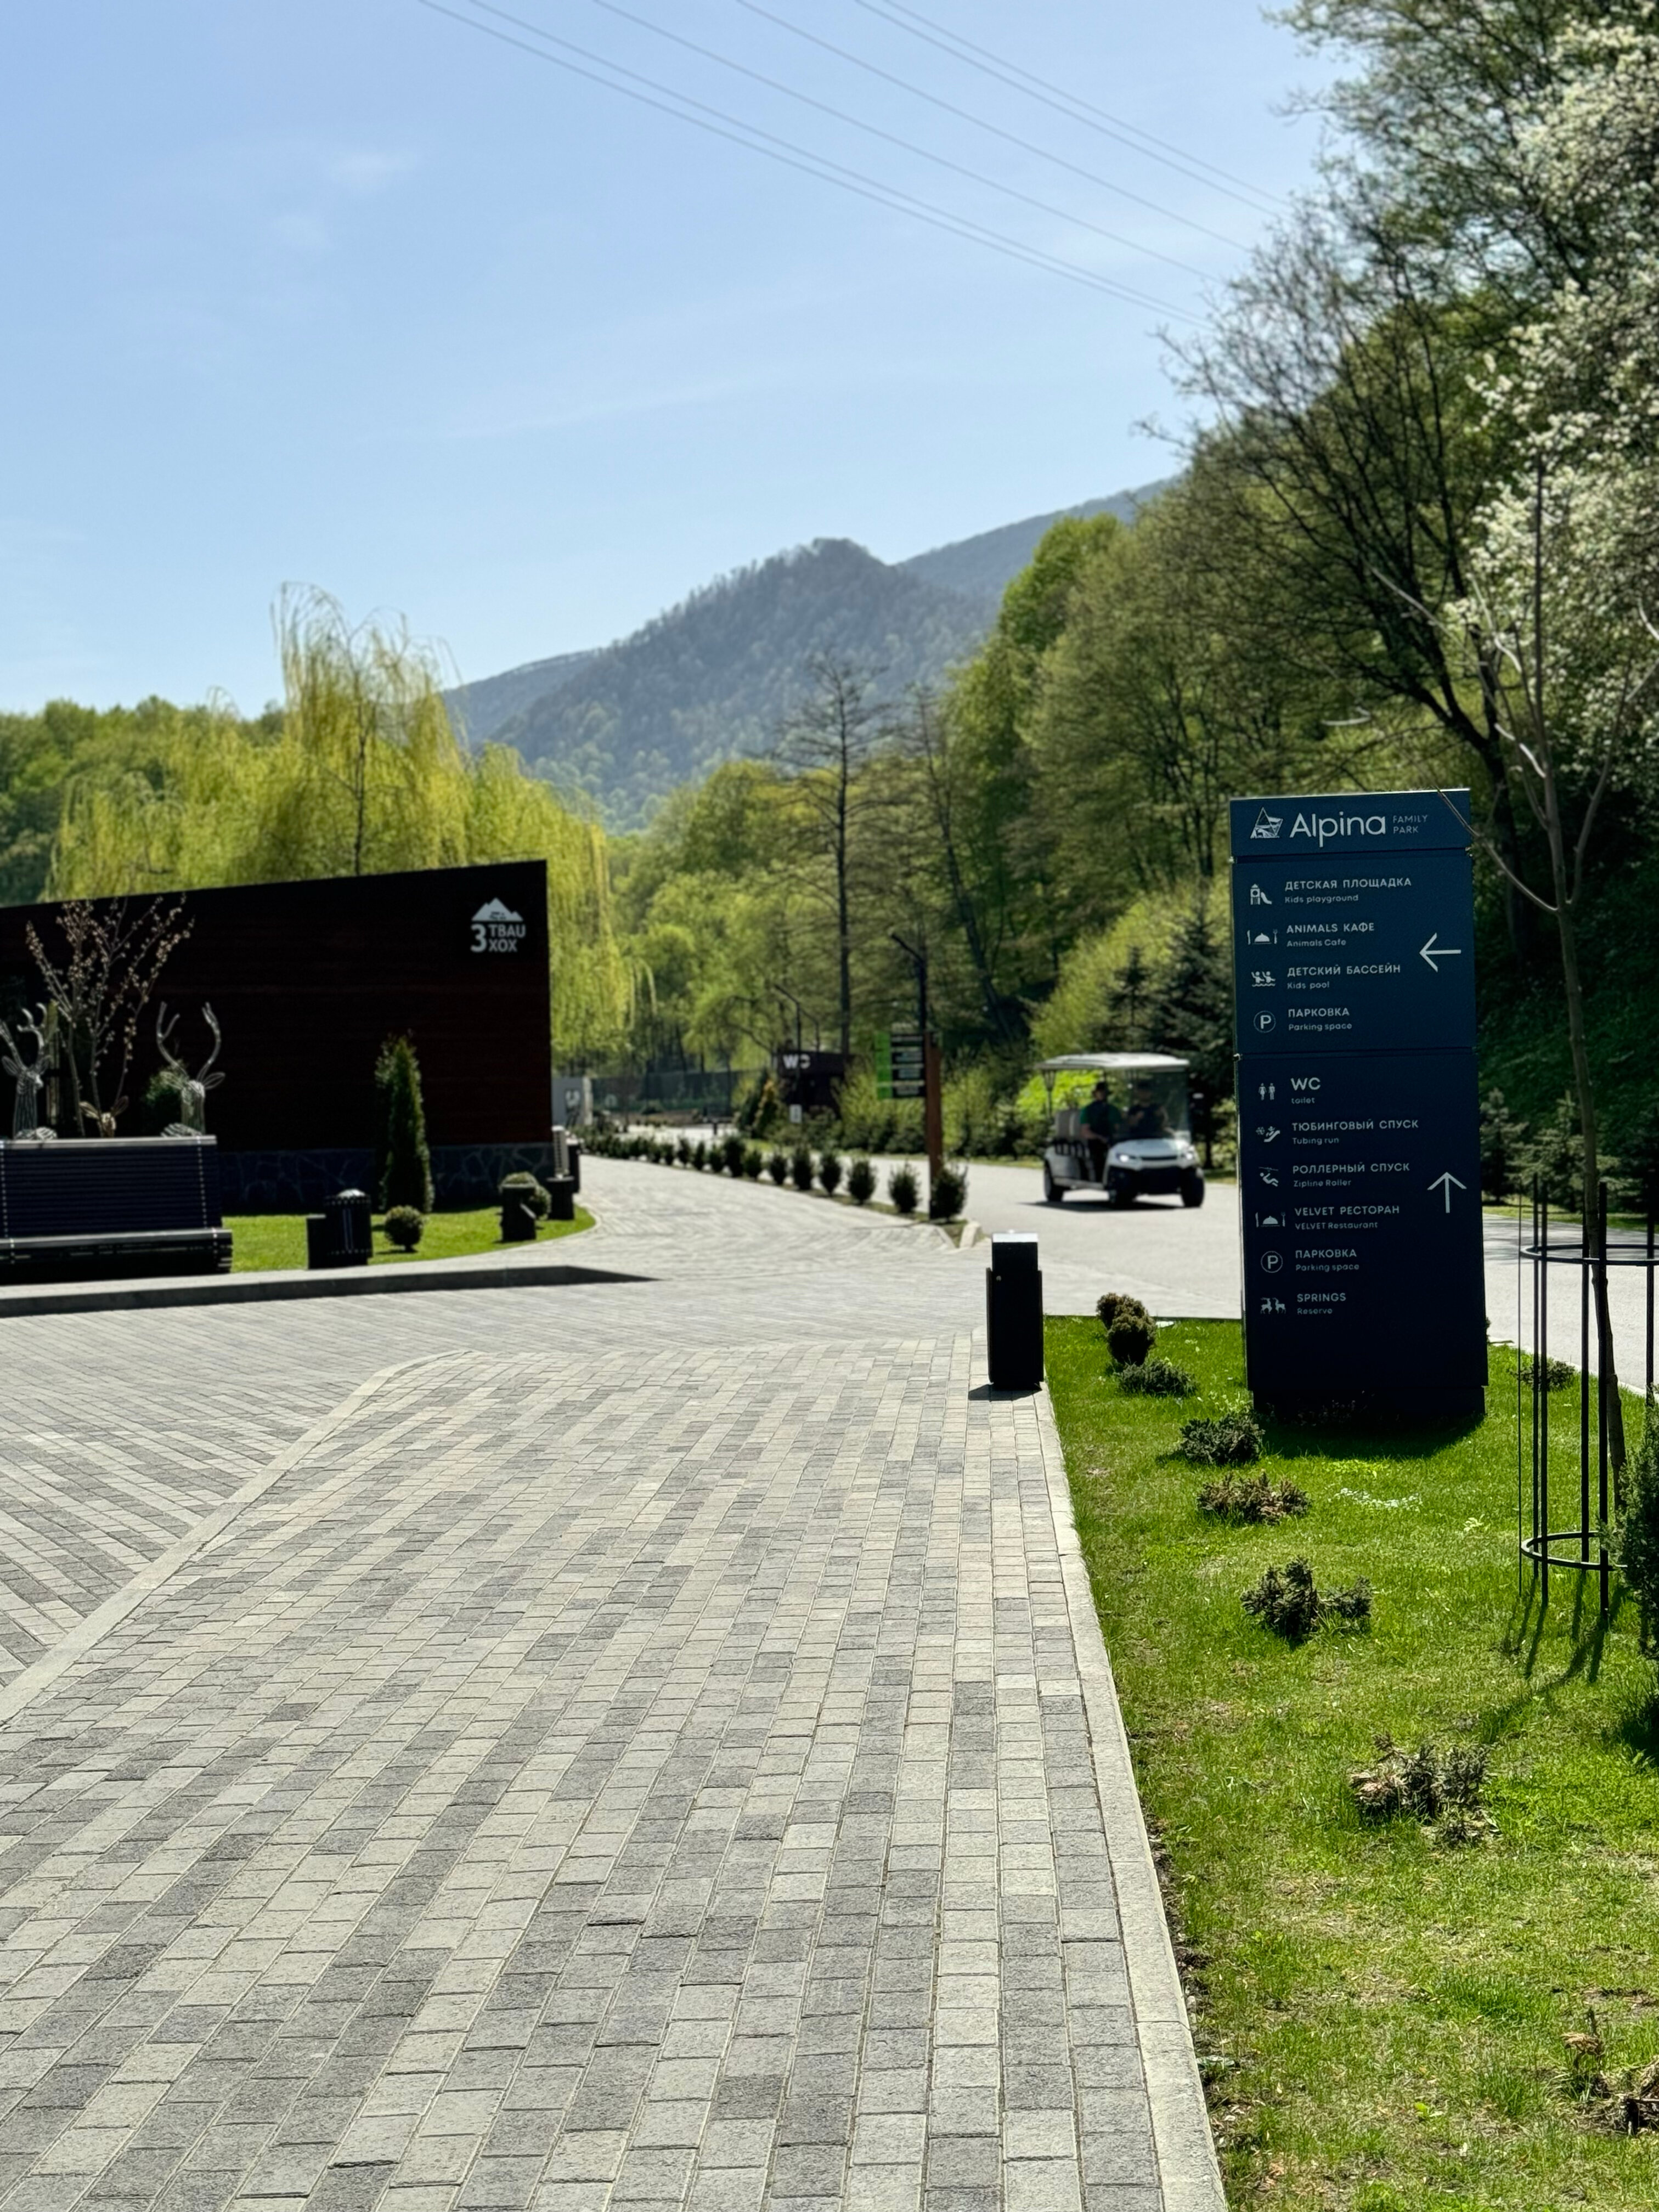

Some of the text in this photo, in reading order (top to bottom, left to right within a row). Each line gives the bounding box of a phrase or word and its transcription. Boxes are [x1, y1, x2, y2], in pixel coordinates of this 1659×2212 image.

[1392, 814, 1428, 823] FAMILY
[1289, 811, 1386, 848] Alpina
[1393, 825, 1418, 834] PARK
[1285, 877, 1412, 891] ДЕТСКАЯ ПЛОЩАДКА
[1306, 894, 1359, 904] playground
[488, 924, 526, 938] TBAU
[1286, 922, 1374, 934] ANIMALS КАФЕ
[1286, 938, 1346, 947] Animals Cafe
[1287, 962, 1401, 978] ДЕТСКИЙ БАССЕЙН
[1310, 981, 1330, 990] pool
[1288, 1007, 1350, 1018] ПАРКОВКА
[1288, 1023, 1352, 1032] Parking space
[1290, 1077, 1321, 1091] WC
[1291, 1119, 1419, 1131] ТЮБИНГОВЫЙ СПУСК
[1292, 1137, 1323, 1146] Tubing
[1293, 1161, 1410, 1174] РОЛЛЕРНЫЙ СПУСК
[1293, 1180, 1324, 1188] Zipline
[1294, 1205, 1400, 1216] VELVET РЕСТОРАН
[1295, 1222, 1326, 1230] VELVET
[1295, 1249, 1357, 1259] ПАРКОВКА
[1295, 1263, 1330, 1273] Parking
[1297, 1292, 1346, 1302] SPRINGS
